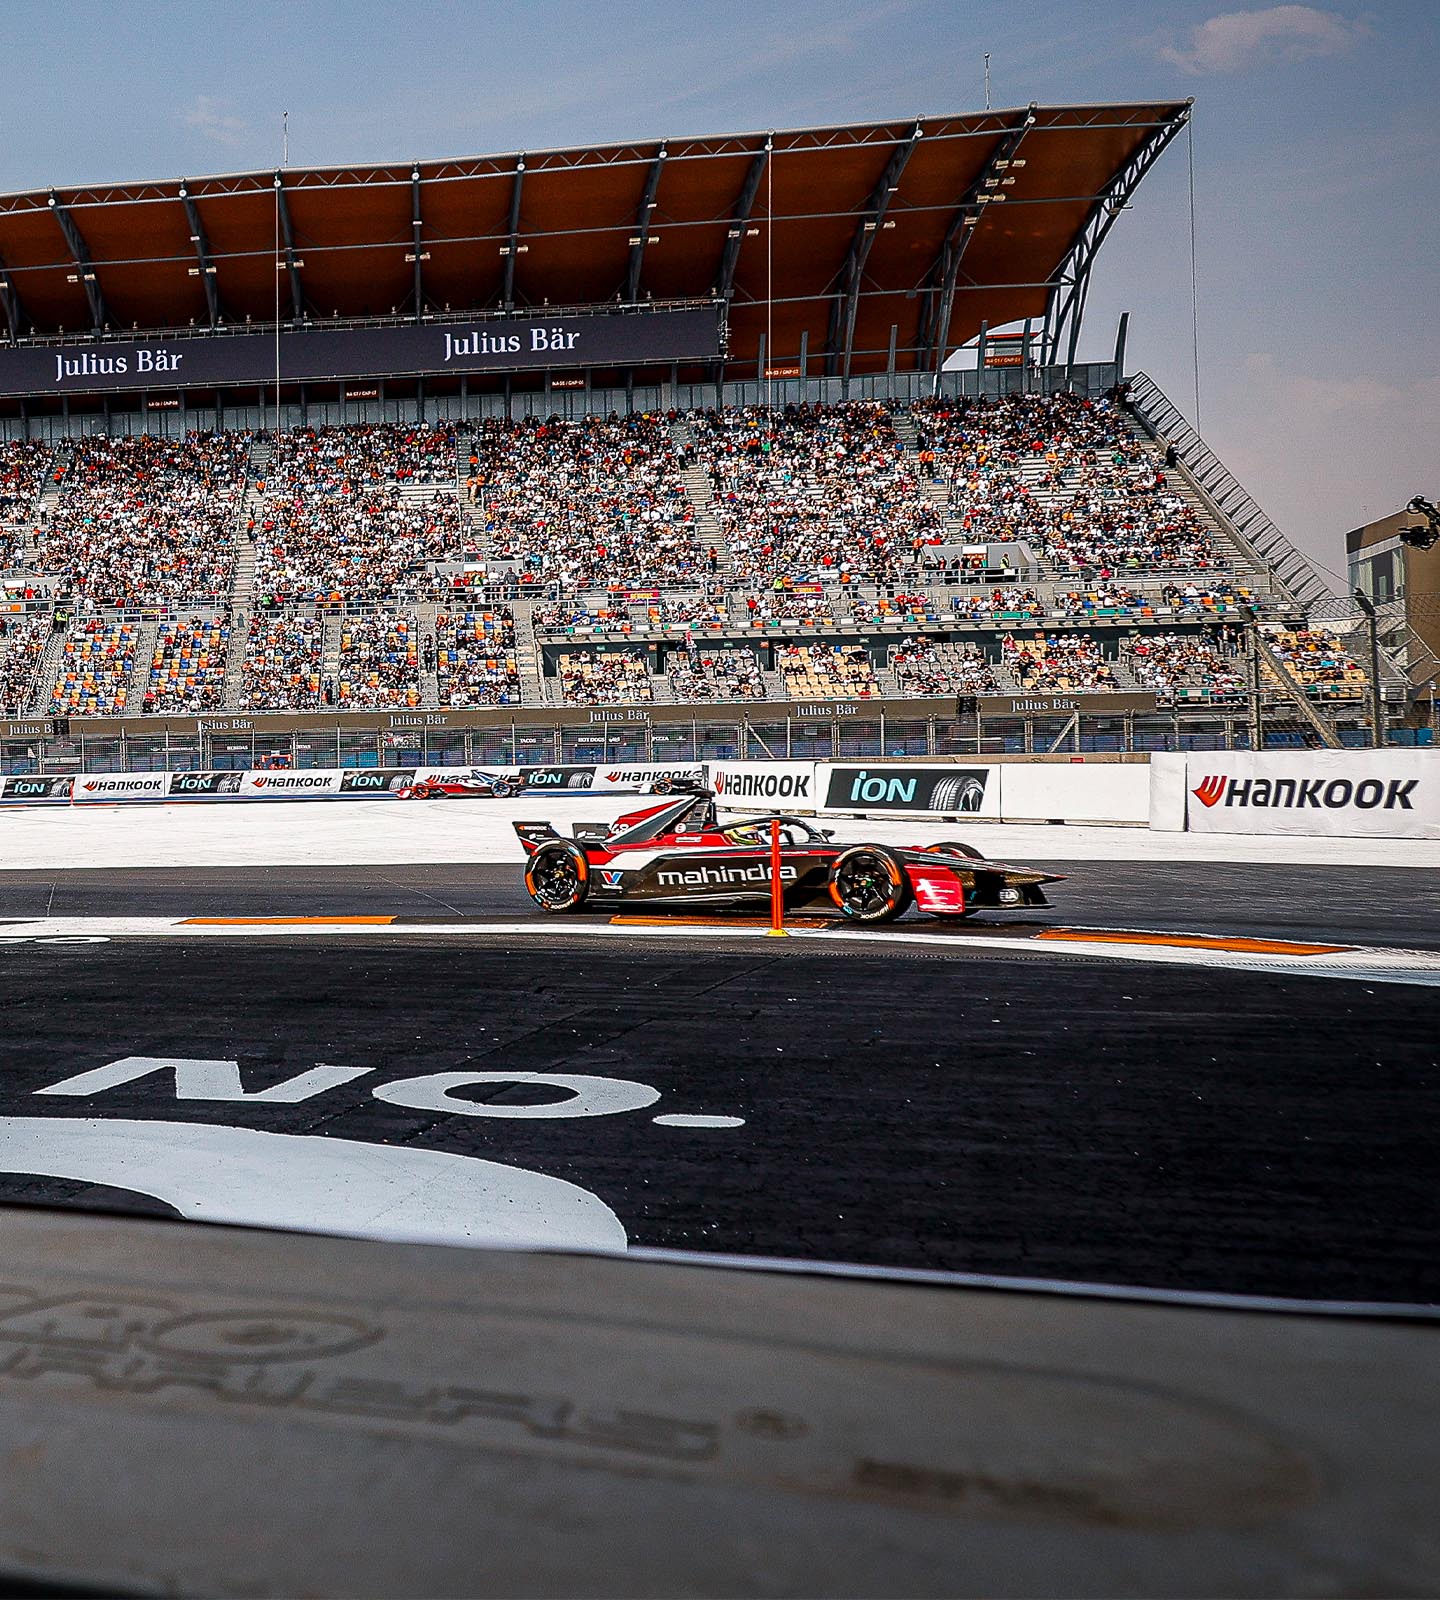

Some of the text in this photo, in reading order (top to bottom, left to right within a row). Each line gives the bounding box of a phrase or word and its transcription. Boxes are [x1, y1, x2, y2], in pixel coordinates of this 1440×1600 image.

[444, 327, 580, 361] Julius Bär
[55, 350, 183, 381] Julius Bär
[796, 704, 858, 717] Julius Bär
[1012, 699, 1076, 712] Julius Bär
[390, 715, 448, 727] Julius Bär
[589, 710, 649, 723] Julius Bär
[9, 723, 40, 736] Julius
[232, 719, 254, 730] Bär
[180, 777, 211, 789] iON
[351, 773, 384, 787] iON
[528, 771, 562, 784] iON
[14, 781, 44, 794] iON
[850, 771, 916, 801] iON
[657, 863, 798, 885] mahindra
[34, 1056, 746, 1129] NO.
